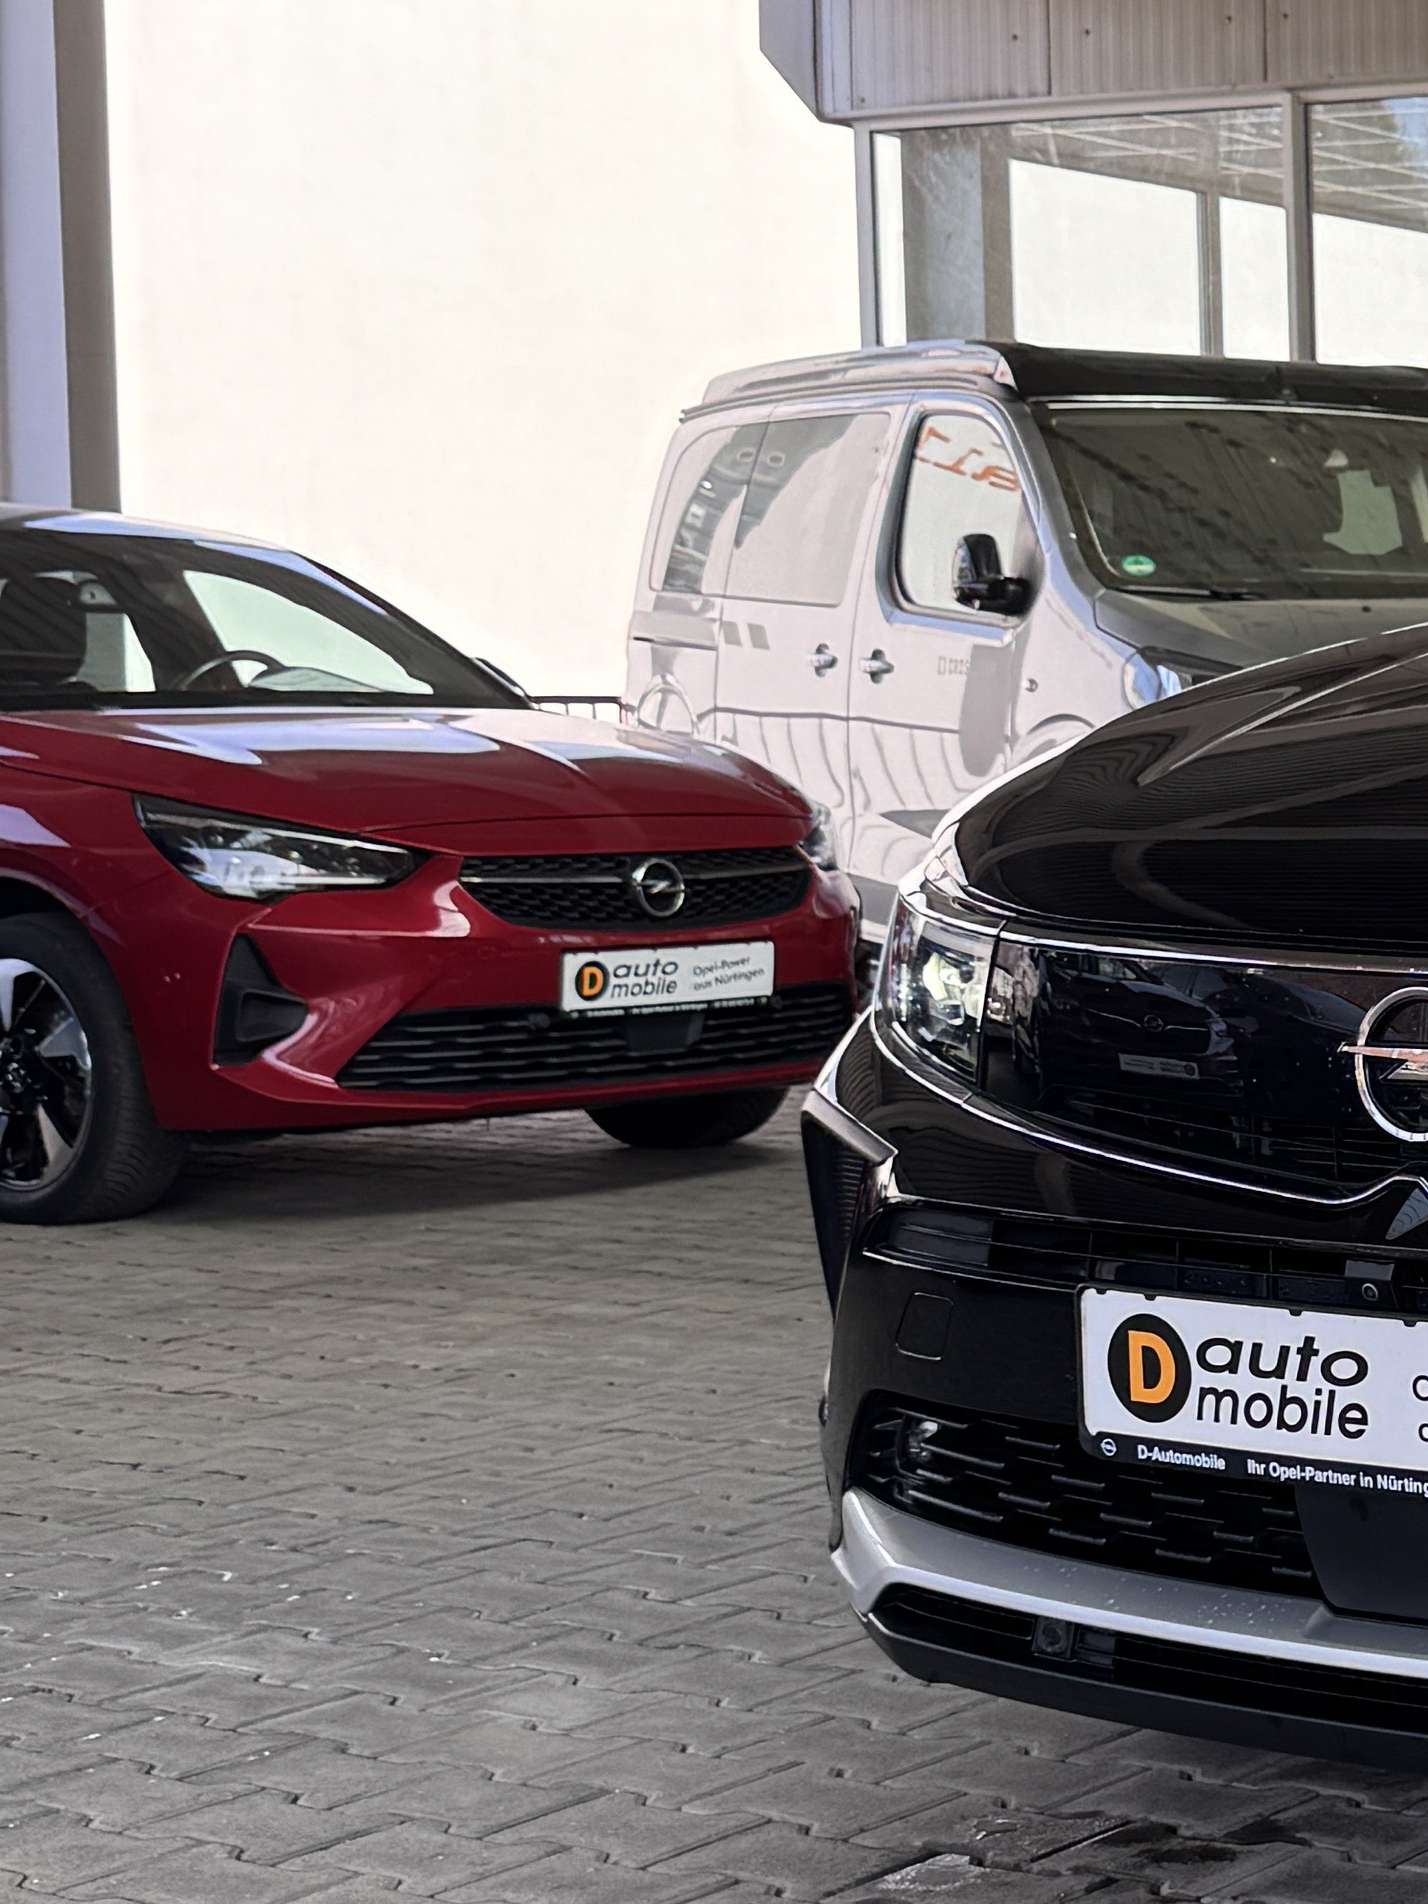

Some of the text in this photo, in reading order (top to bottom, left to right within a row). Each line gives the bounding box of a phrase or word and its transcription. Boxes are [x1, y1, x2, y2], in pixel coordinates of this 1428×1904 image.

[583, 965, 603, 996] D
[610, 976, 677, 997] mobile
[613, 958, 679, 979] auto
[1128, 1330, 1176, 1404] D
[1196, 1336, 1369, 1387] auto
[1197, 1384, 1369, 1439] mobile
[1137, 1444, 1226, 1471] D-Automobile
[1247, 1458, 1265, 1476] Ihr
[1269, 1460, 1357, 1487] Opel-Partner
[1359, 1472, 1374, 1489] in
